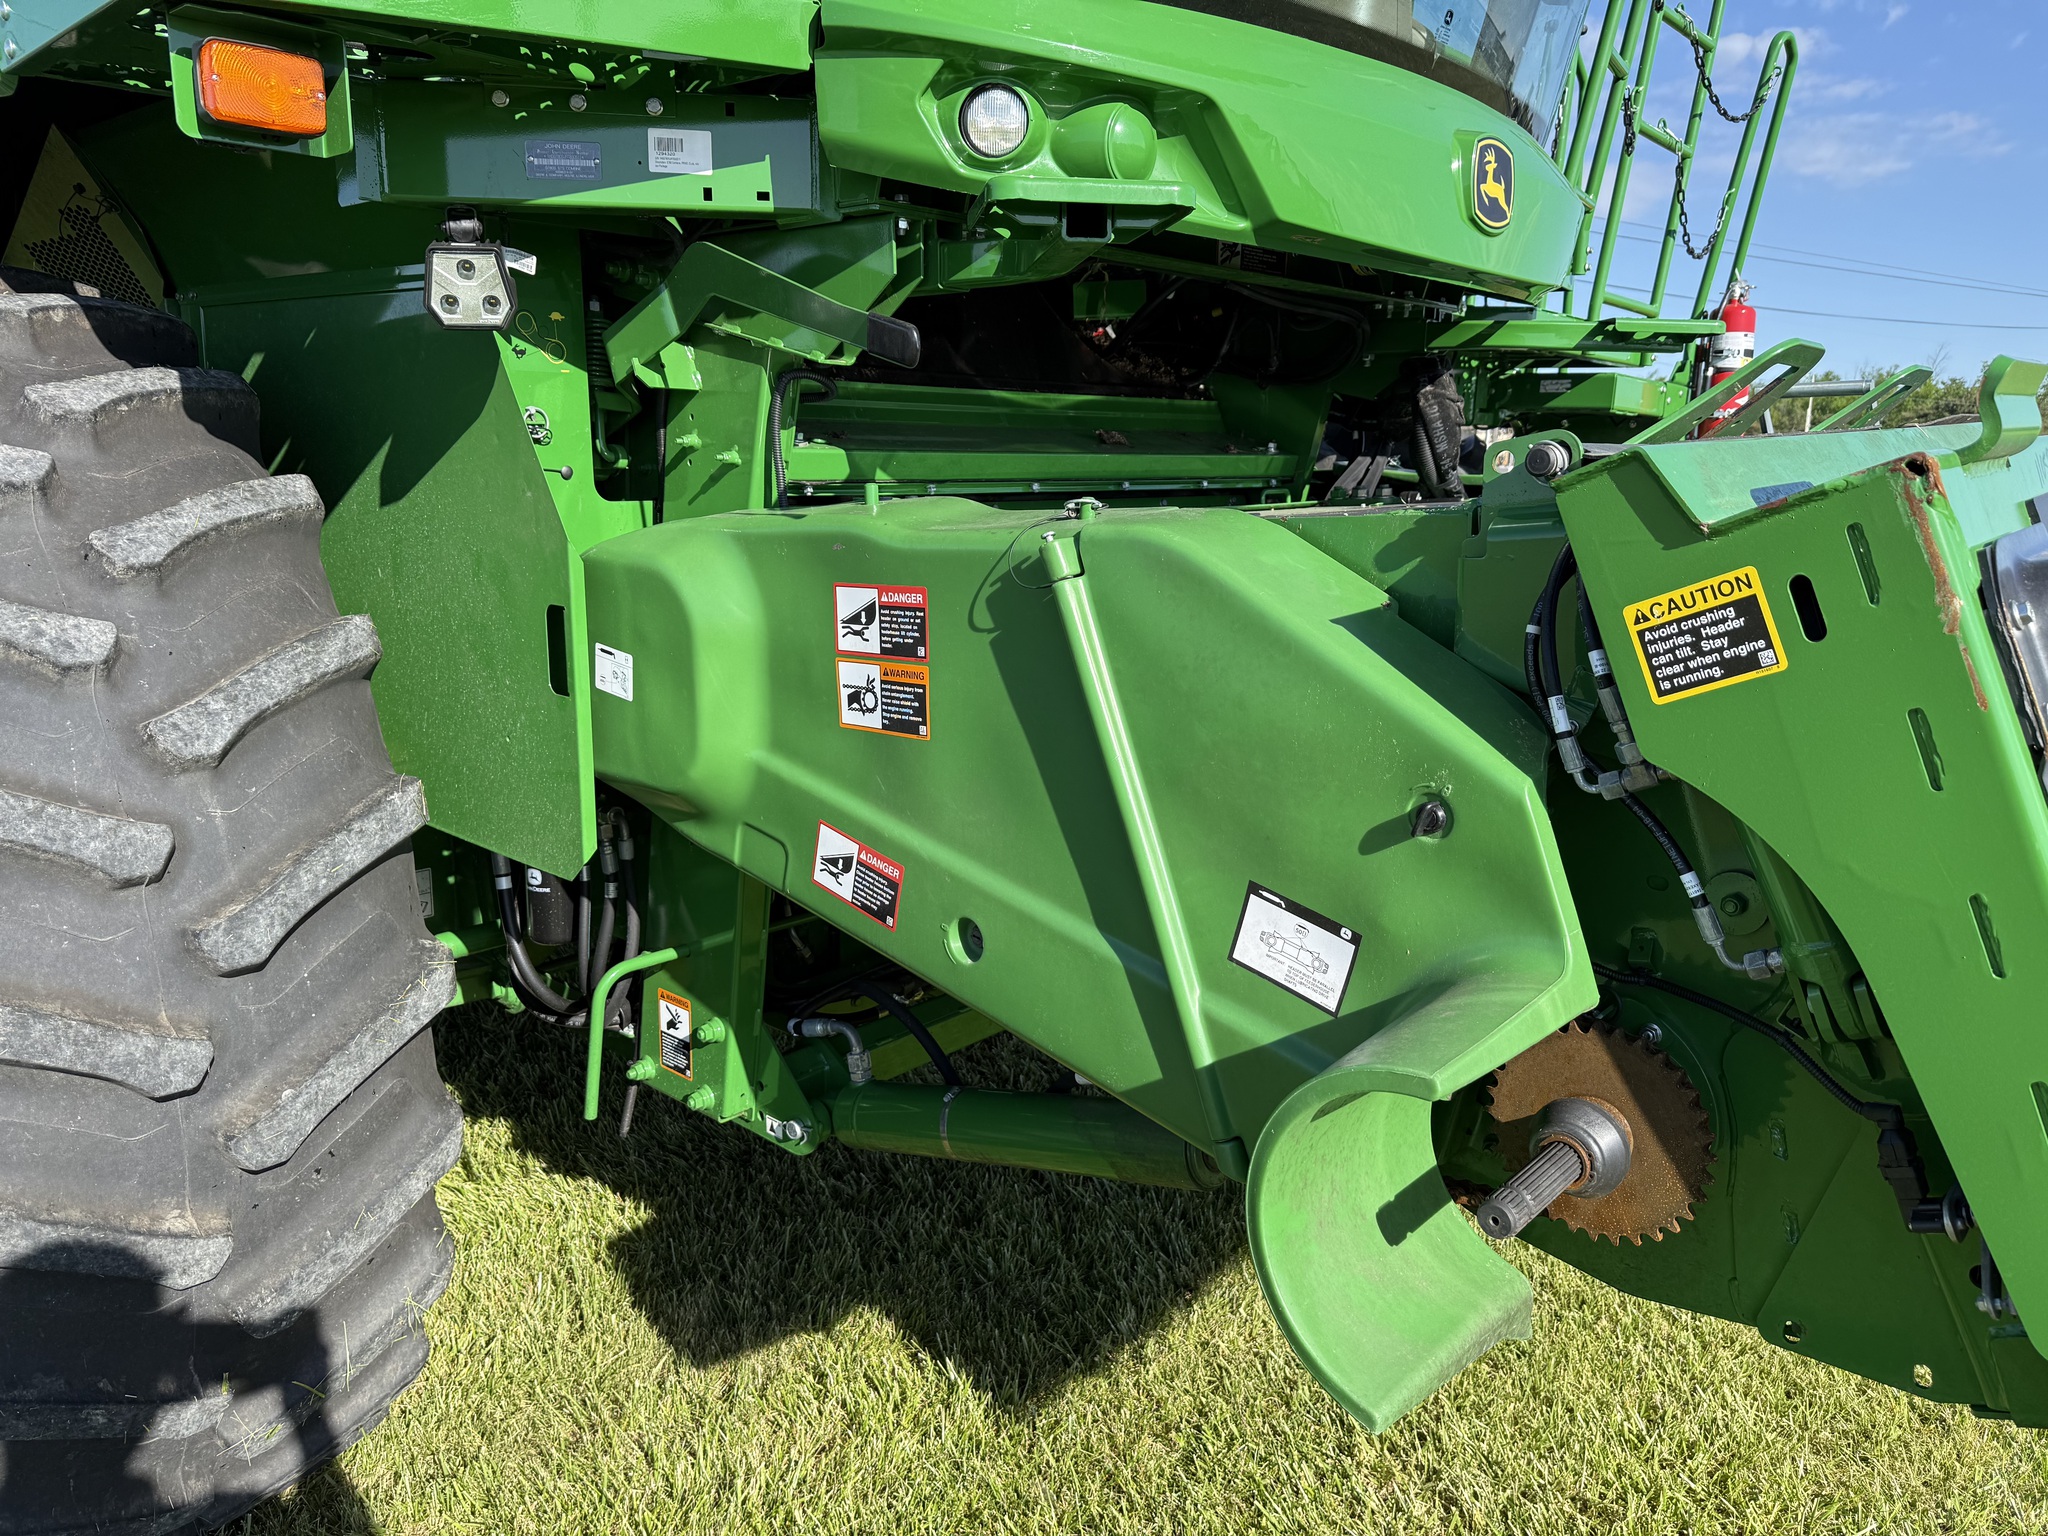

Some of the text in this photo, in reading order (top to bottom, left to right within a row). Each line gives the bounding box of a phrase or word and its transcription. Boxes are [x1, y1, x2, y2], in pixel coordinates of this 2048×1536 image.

[1432, 420, 1448, 453] MSHA
[888, 593, 923, 603] DANGER
[1649, 572, 1753, 619] CAUTION
[1644, 606, 1736, 642] Avoid crushing
[1647, 617, 1745, 654] injuries. Header
[1527, 644, 1537, 681] exceeds
[1652, 635, 1728, 666] can tilt. Stay
[1655, 638, 1766, 678] clear when engine
[889, 669, 924, 680] WARNING
[1659, 665, 1725, 691] is running.
[867, 854, 899, 879] DANGER
[666, 994, 688, 1008] WARNING
[1317, 979, 1335, 993] PARALLEL
